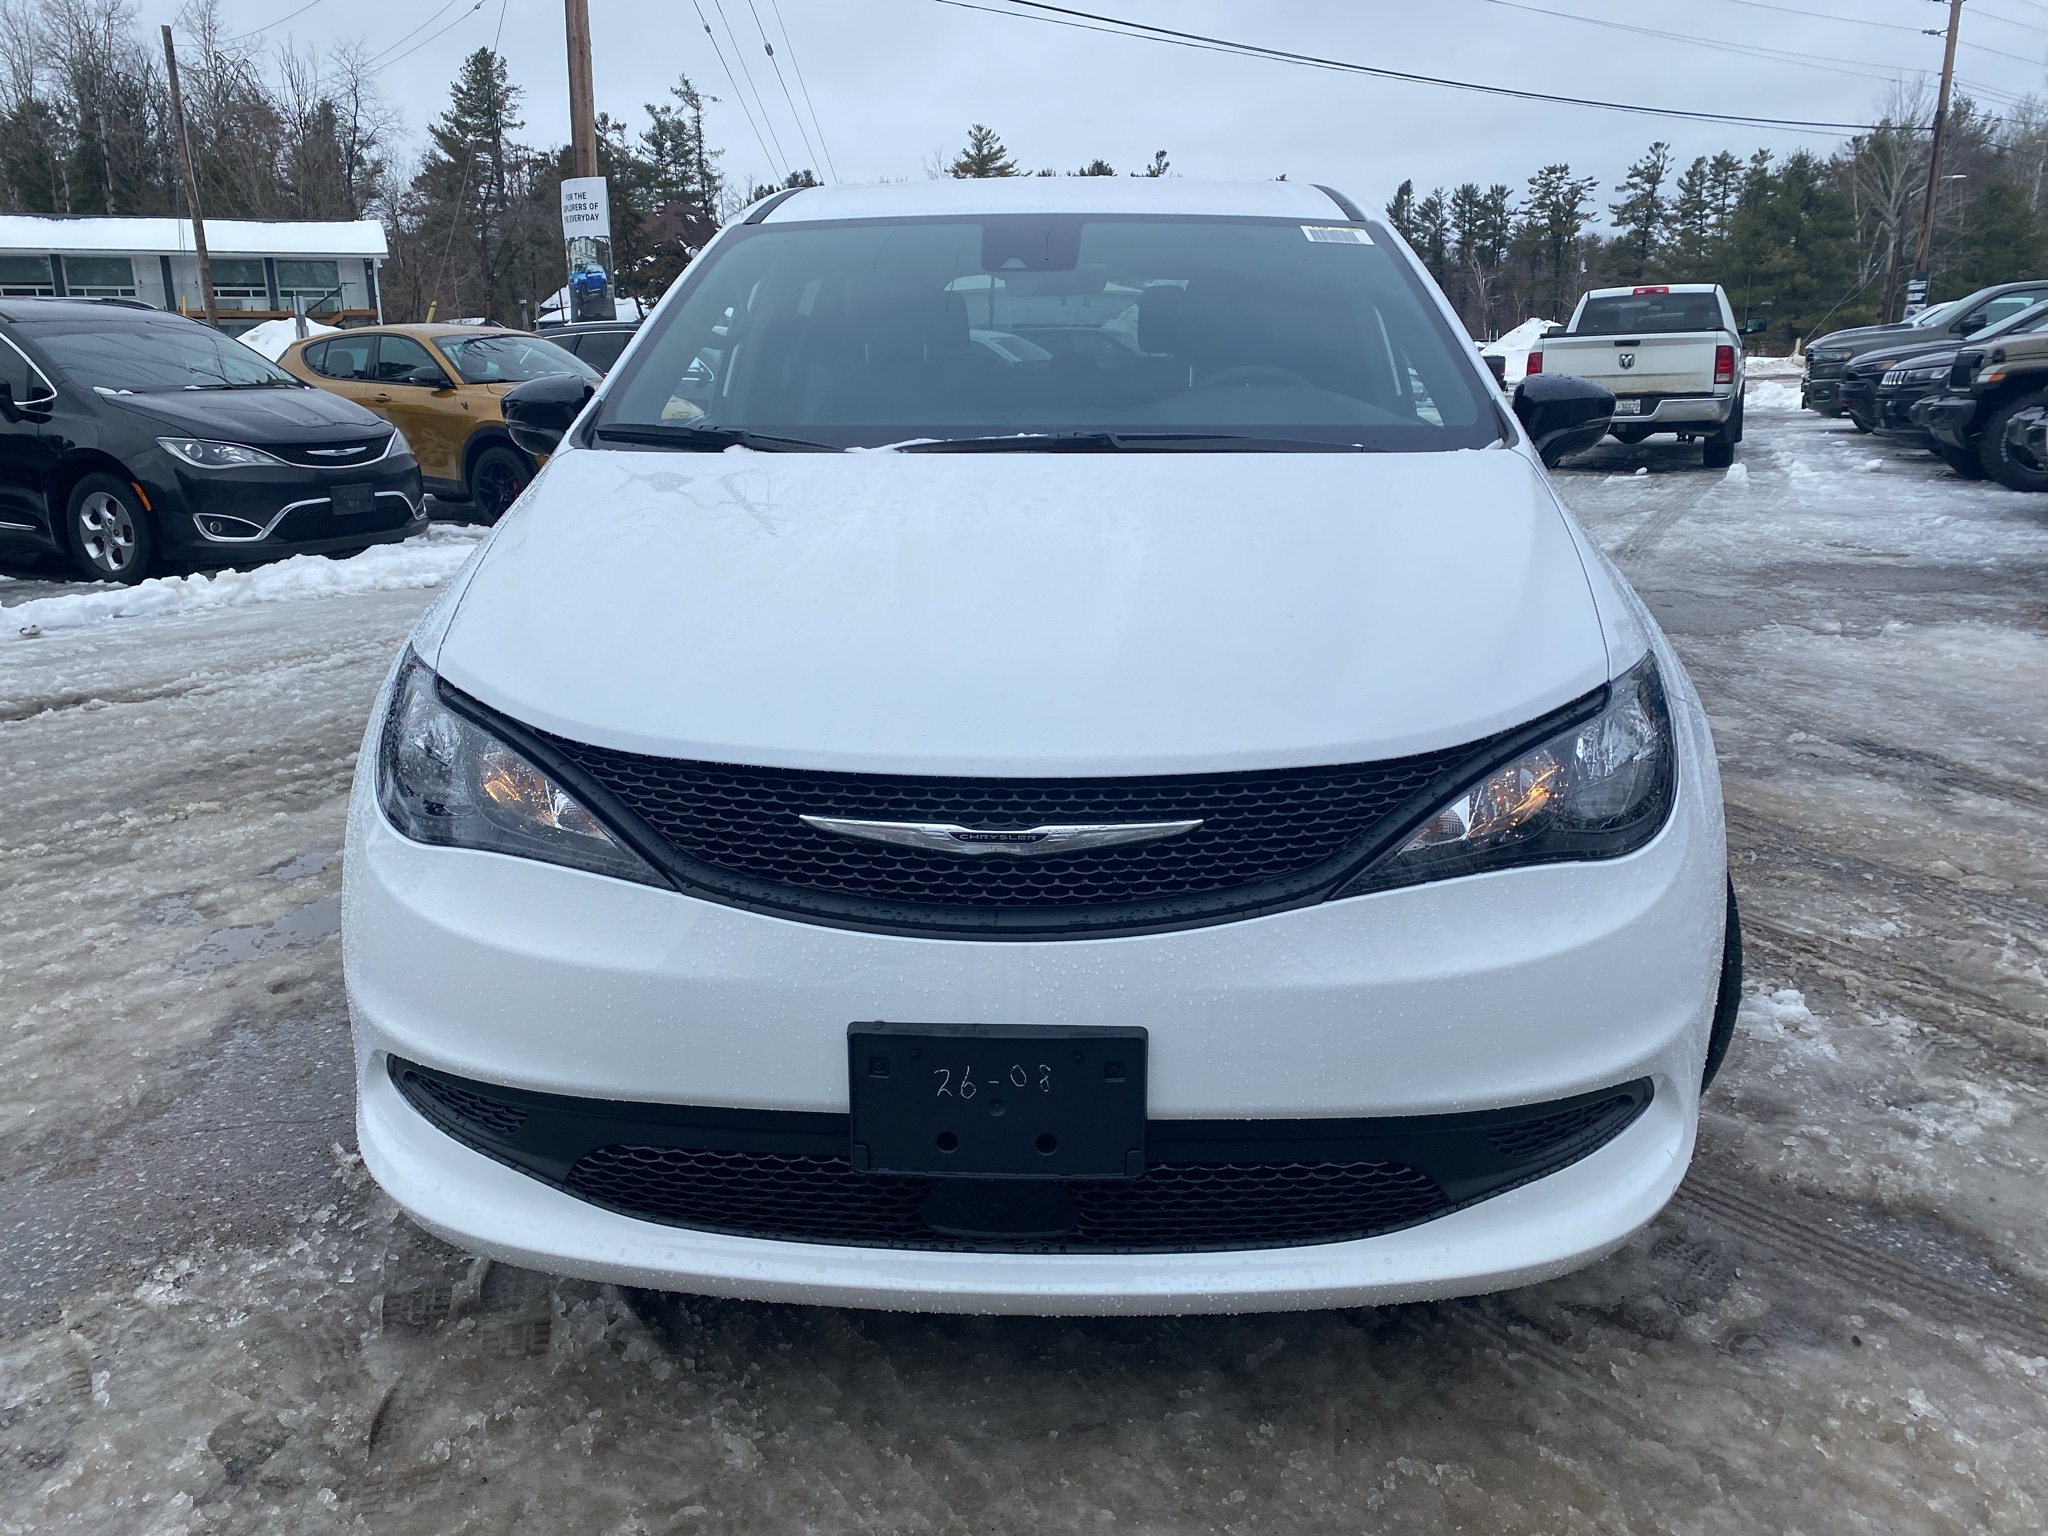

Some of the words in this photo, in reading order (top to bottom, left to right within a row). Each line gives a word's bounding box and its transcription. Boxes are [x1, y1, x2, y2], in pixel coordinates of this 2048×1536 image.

[565, 193, 573, 201] FOR
[574, 192, 587, 200] THE
[589, 202, 599, 210] OF
[569, 213, 600, 223] EVERYDAY
[934, 1064, 1051, 1099] 26-08
